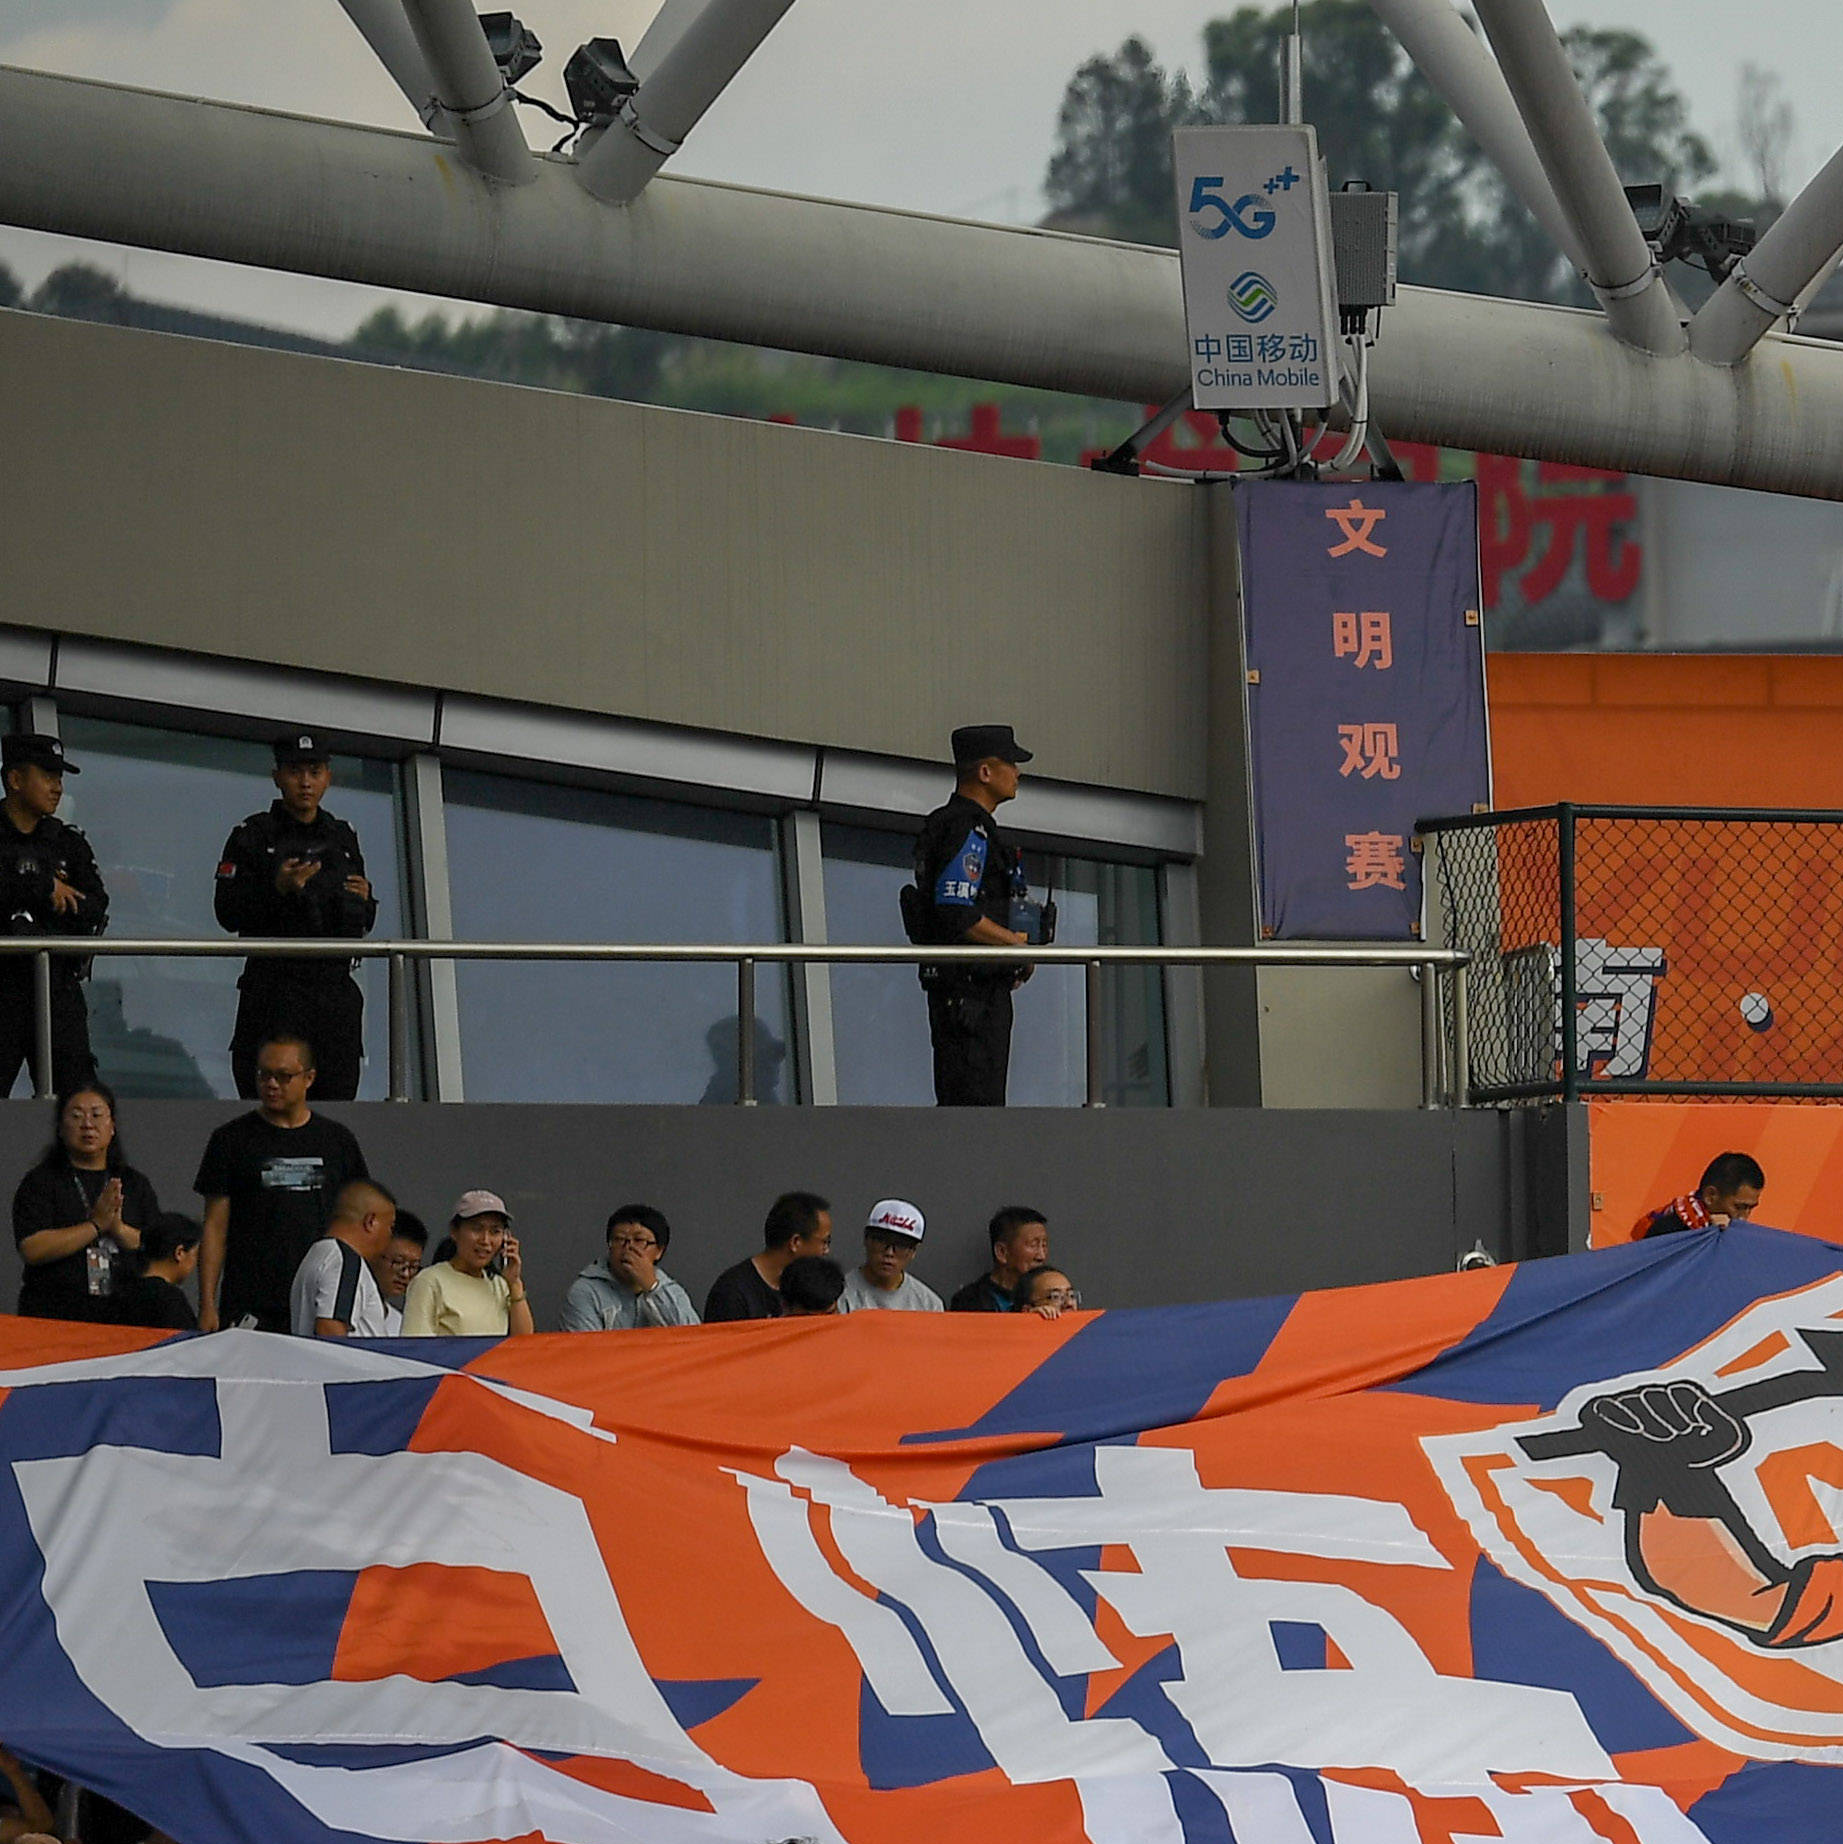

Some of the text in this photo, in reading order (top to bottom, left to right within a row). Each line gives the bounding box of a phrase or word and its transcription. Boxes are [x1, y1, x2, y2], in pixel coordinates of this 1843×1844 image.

[1195, 334, 1318, 364] 中国移动
[1197, 369, 1320, 387] China Mobile
[1325, 499, 1406, 891] 文明观赛
